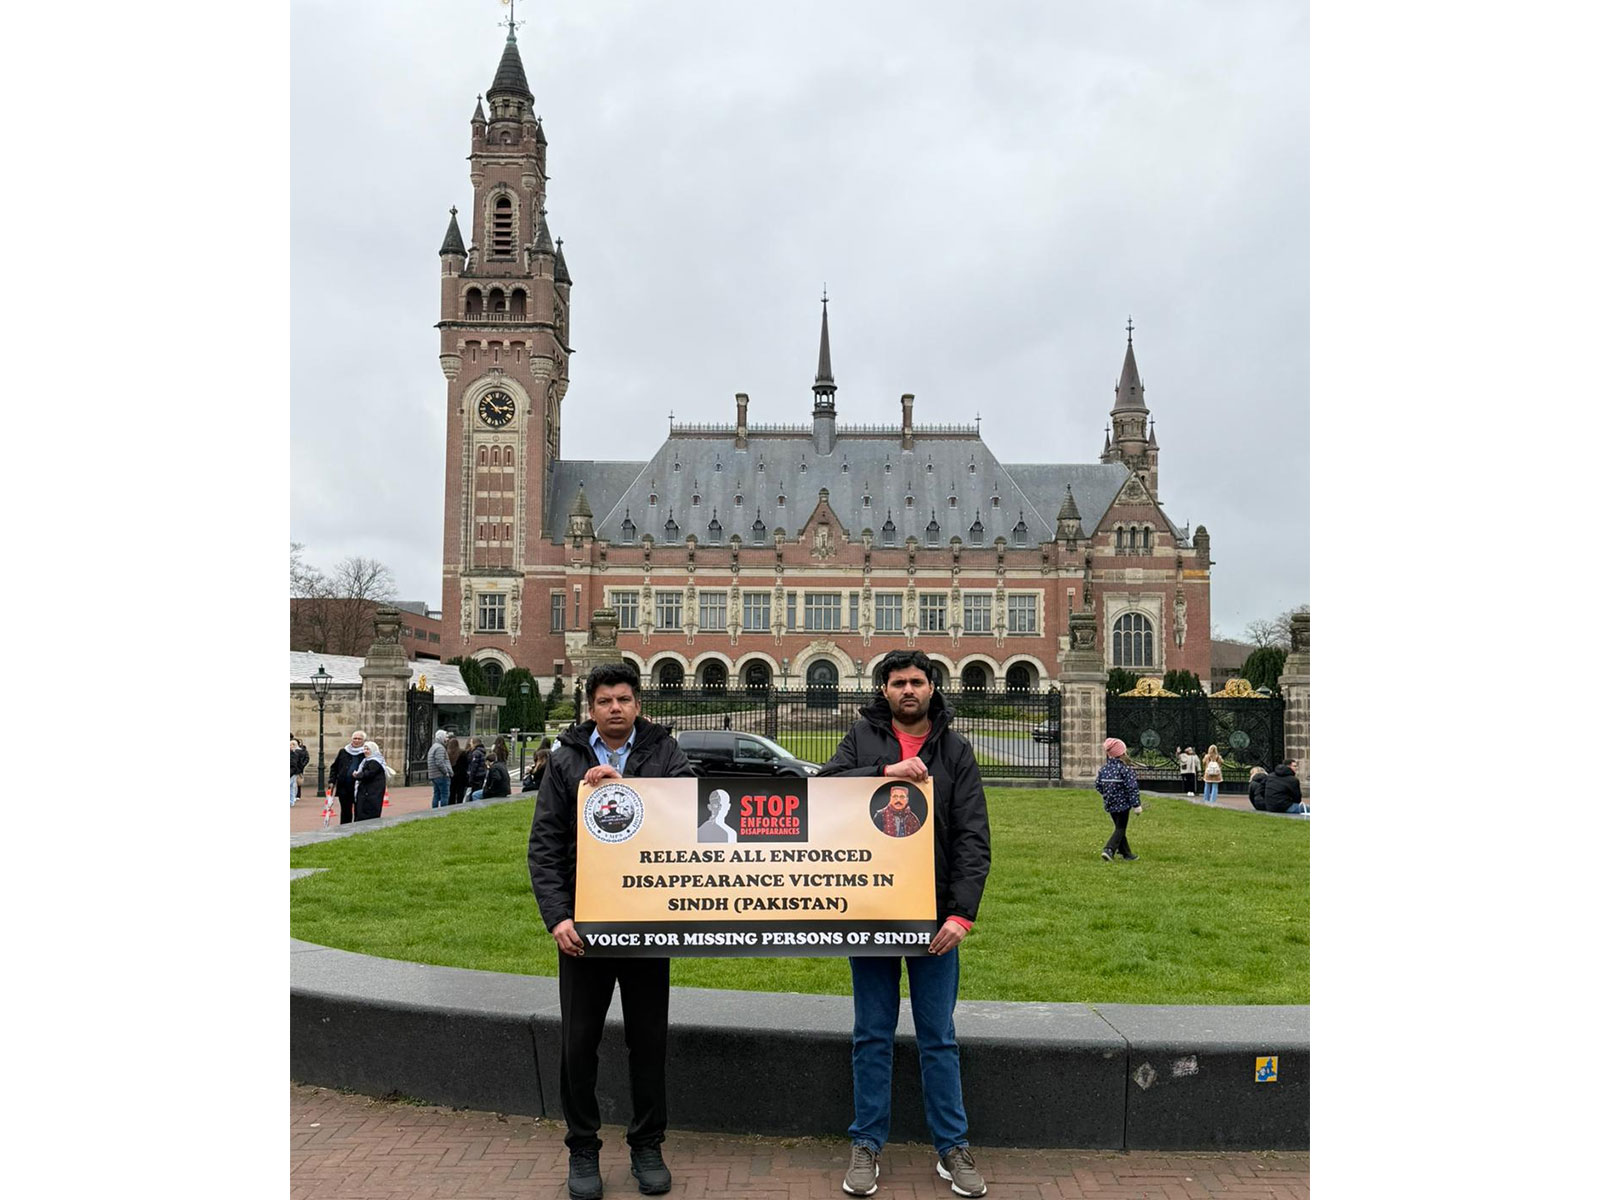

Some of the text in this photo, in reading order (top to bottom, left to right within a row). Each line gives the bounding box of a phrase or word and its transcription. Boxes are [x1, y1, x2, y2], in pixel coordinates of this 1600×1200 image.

[740, 795, 801, 816] STOP
[740, 817, 801, 829] ENFORCED
[740, 828, 801, 836] DISAPPEARANCES
[639, 849, 872, 864] RELEASE ALL ENFORCED
[622, 873, 894, 888] DISAPPEARANCE VICTIMS IN
[668, 896, 849, 913] SINDH (PAKISTAN)
[586, 931, 931, 947] VOICE FOR MISSING PERSONS OF SINDH
